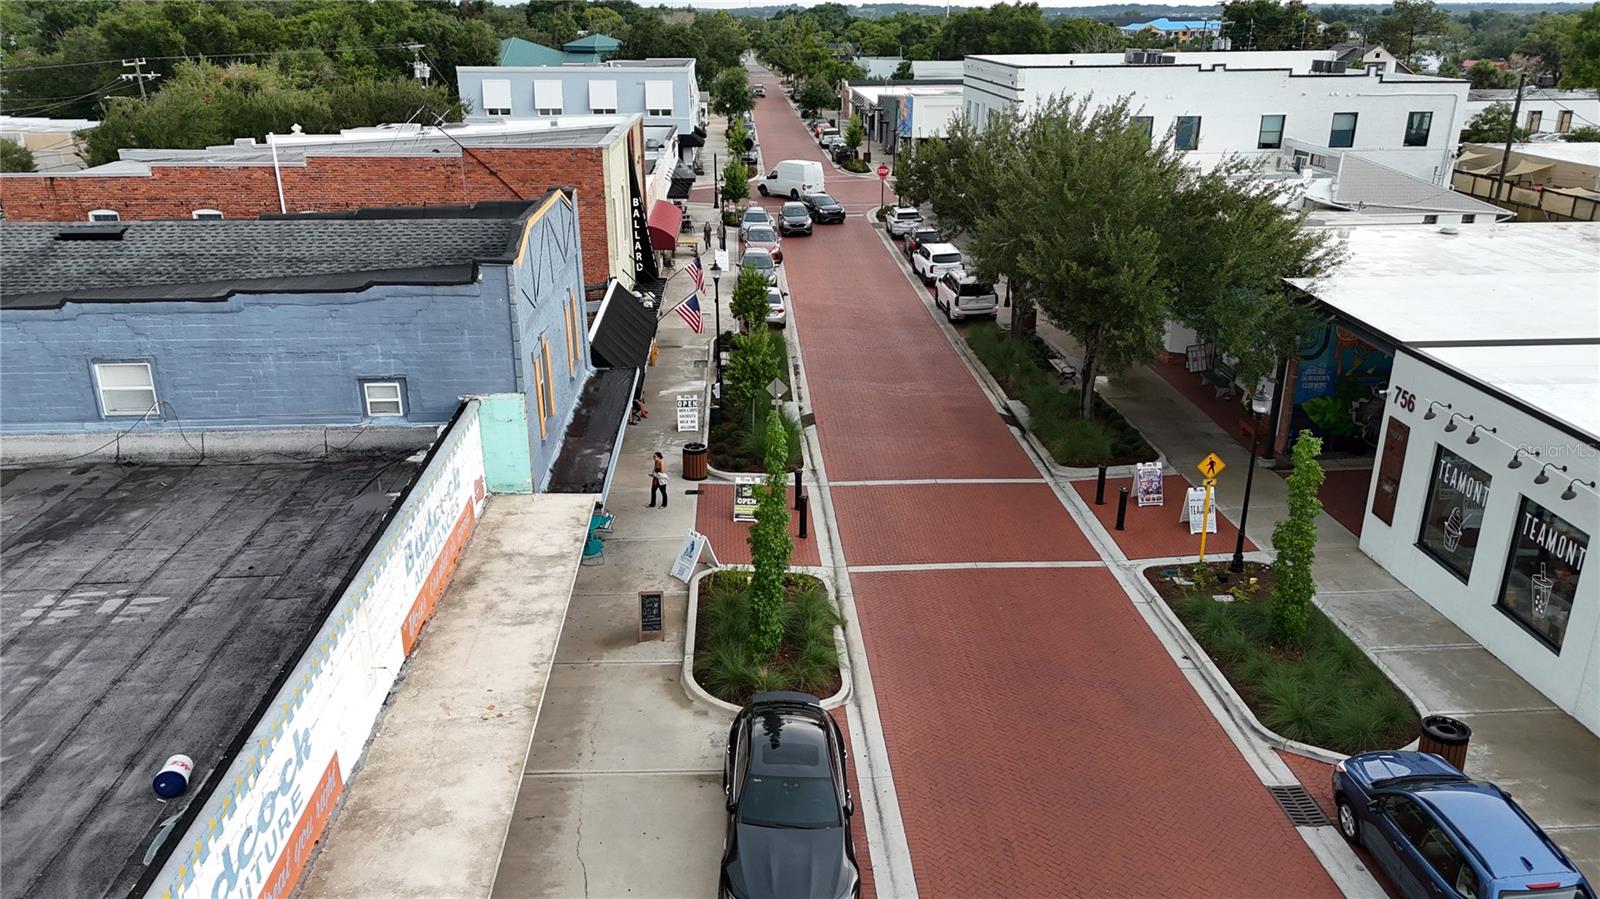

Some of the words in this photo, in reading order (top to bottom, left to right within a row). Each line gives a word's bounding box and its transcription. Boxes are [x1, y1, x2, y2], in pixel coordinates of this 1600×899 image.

[632, 197, 644, 271] BALLARD
[677, 400, 698, 408] OPEN
[1394, 386, 1416, 413] 756
[1438, 459, 1491, 508] TEAMONT
[1523, 512, 1587, 571] TEAMONT
